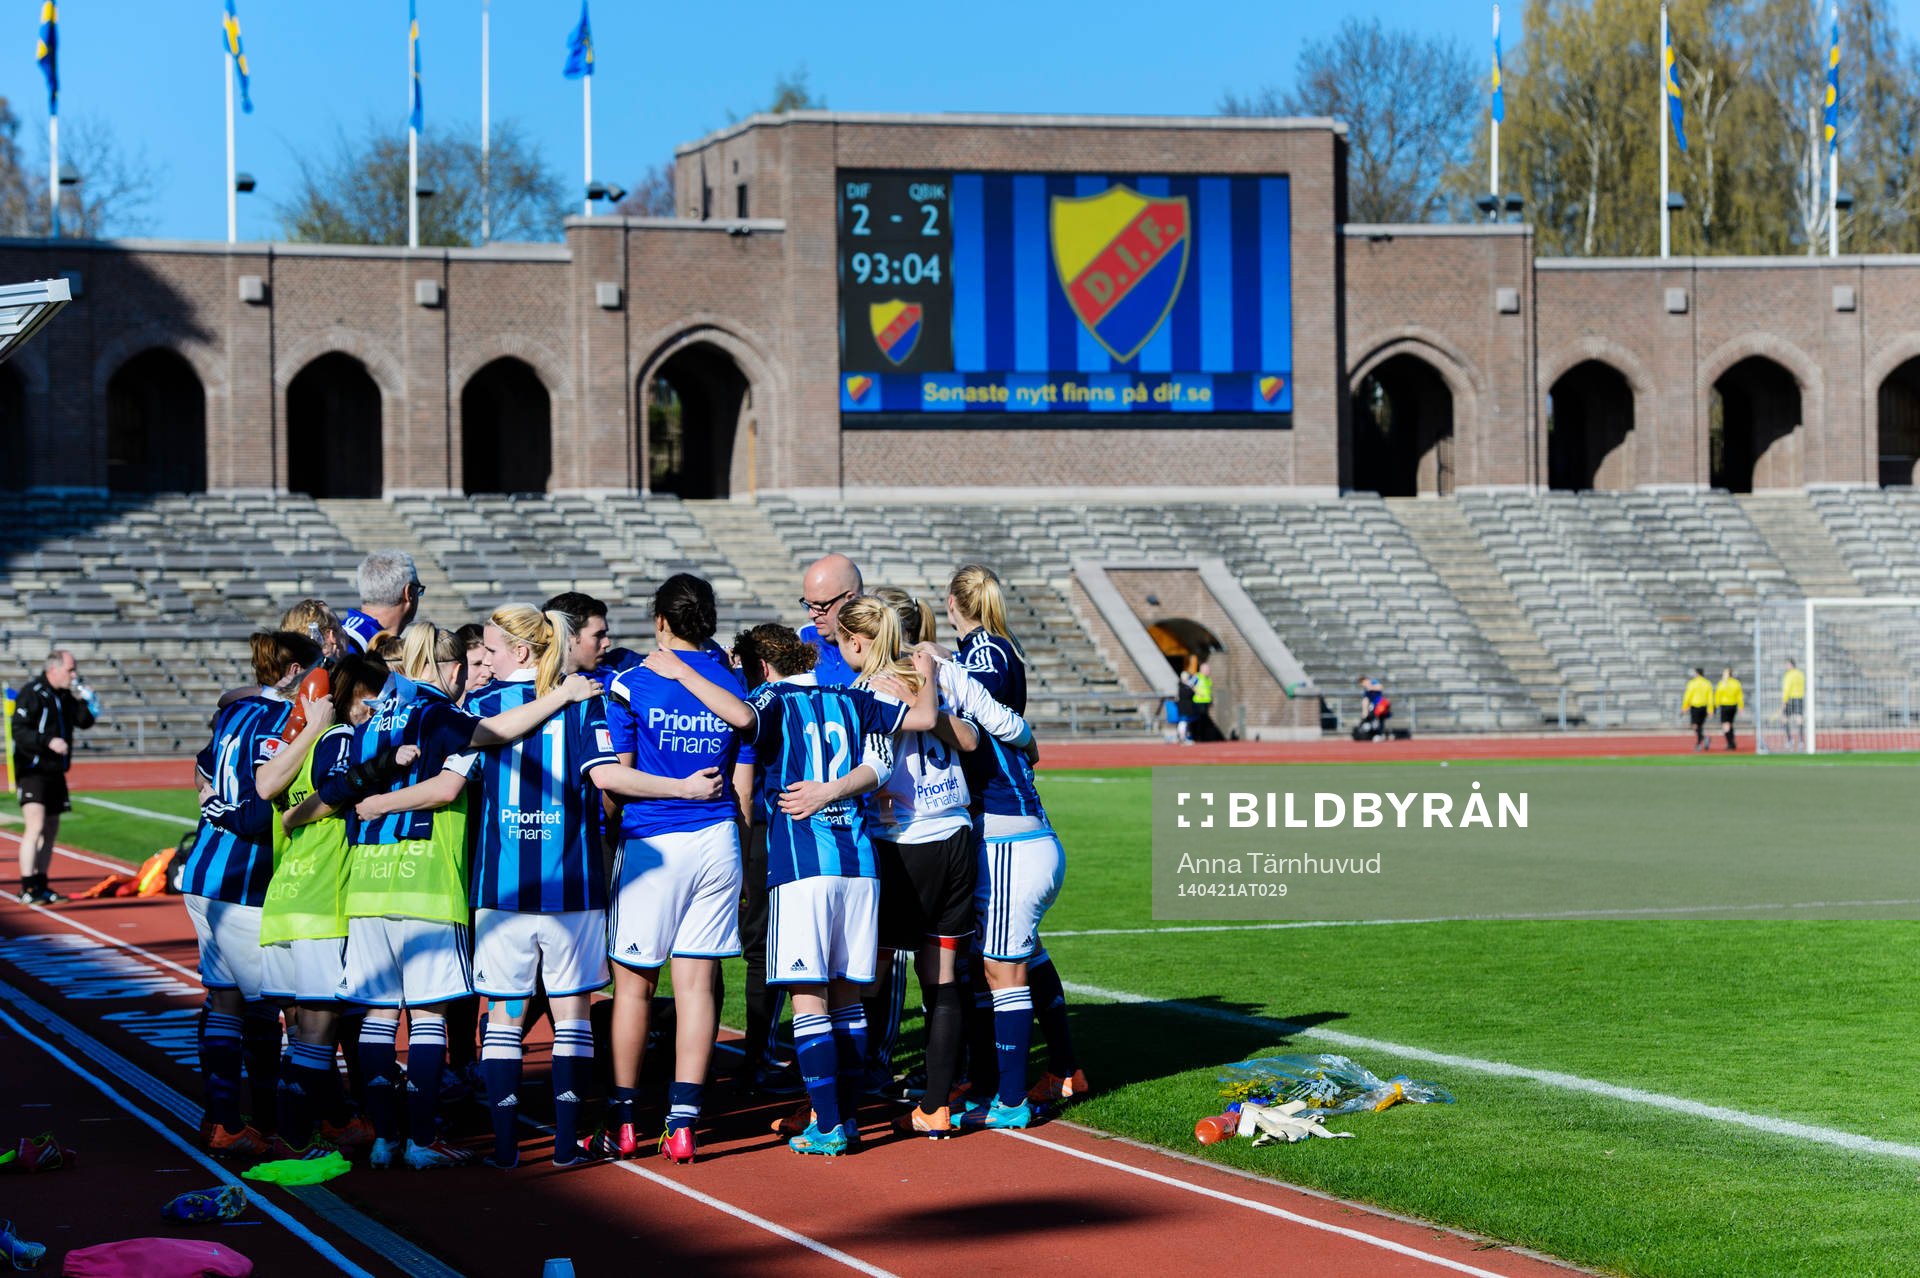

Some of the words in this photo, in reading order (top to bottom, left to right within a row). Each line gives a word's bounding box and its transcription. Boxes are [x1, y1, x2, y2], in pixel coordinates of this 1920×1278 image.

[846, 182, 871, 199] DIF
[852, 204, 871, 236] 2
[921, 204, 940, 236] 2
[852, 252, 941, 285] 93:04
[1083, 215, 1176, 305] D.I.F.
[924, 382, 1009, 403] Senaste
[1016, 384, 1057, 406] nytt
[1063, 382, 1115, 403] finns
[1122, 381, 1148, 406] på
[1153, 382, 1211, 403] dif.se
[648, 707, 734, 733] Priorite
[659, 729, 721, 754] Finans
[805, 721, 848, 784] 12
[215, 734, 241, 806] 16
[508, 719, 563, 806] 11
[501, 808, 561, 824] Prioritet
[508, 825, 552, 840] Finans
